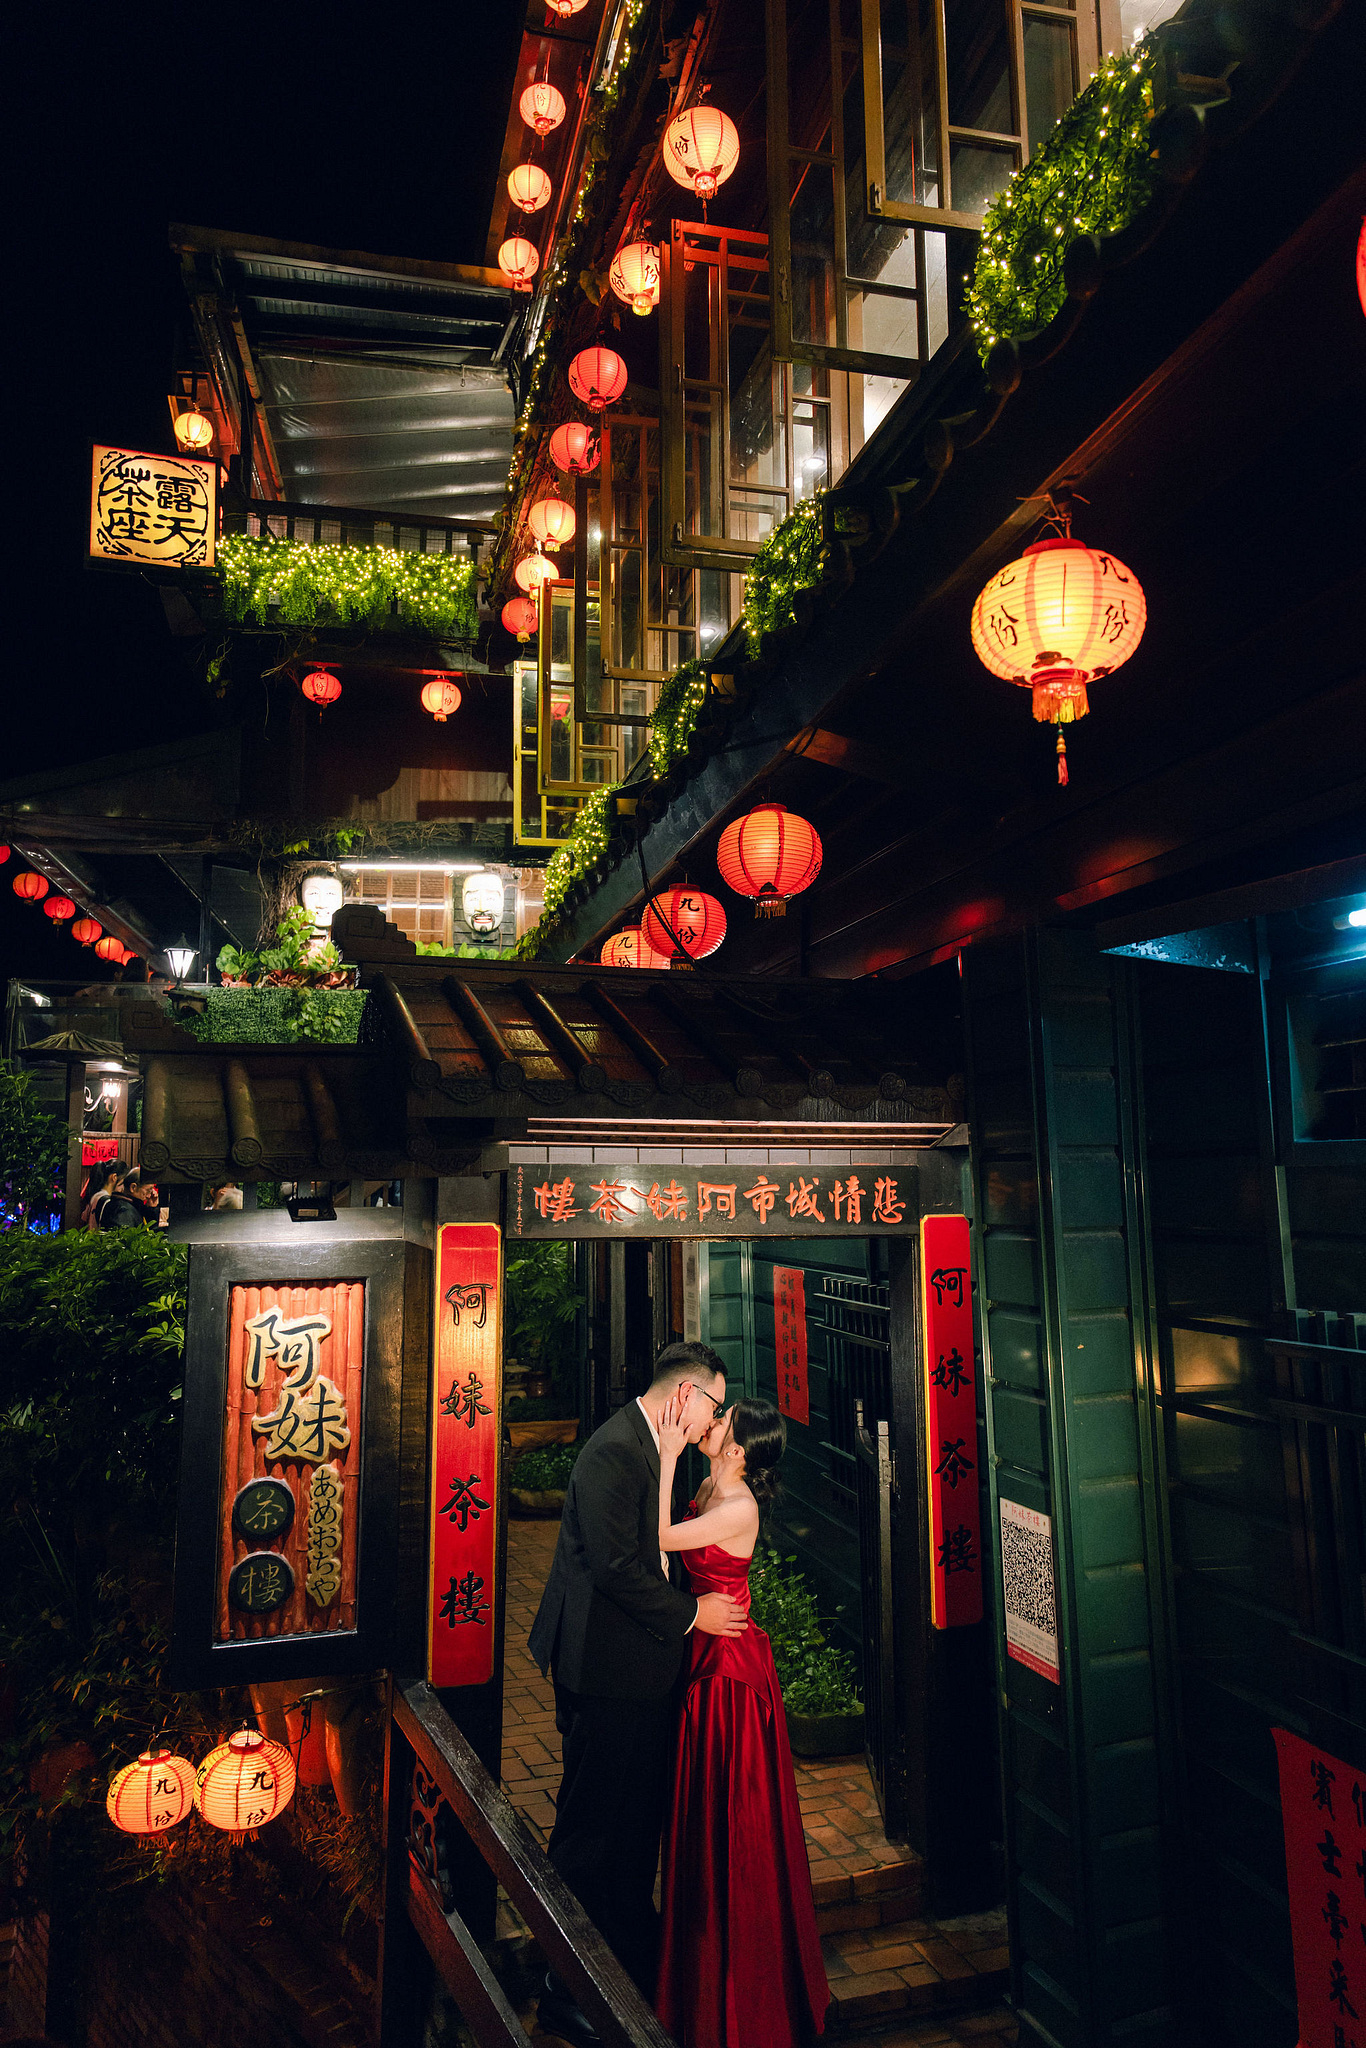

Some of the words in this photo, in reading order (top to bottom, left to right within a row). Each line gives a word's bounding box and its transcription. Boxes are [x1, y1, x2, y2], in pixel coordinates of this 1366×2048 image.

[645, 246, 660, 284] 九份
[100, 467, 155, 543] 茶座
[153, 473, 206, 551] 露天
[990, 568, 1019, 650] 九份
[1099, 555, 1130, 643] 九份
[316, 674, 325, 692] 九份
[443, 685, 455, 706] 九份
[678, 898, 700, 945] 九份
[930, 1267, 979, 1576] 阿妹茶樓
[439, 1283, 494, 1629] 阿妹茶樓
[154, 1778, 176, 1827] 九份
[247, 1771, 274, 1826] 九份
